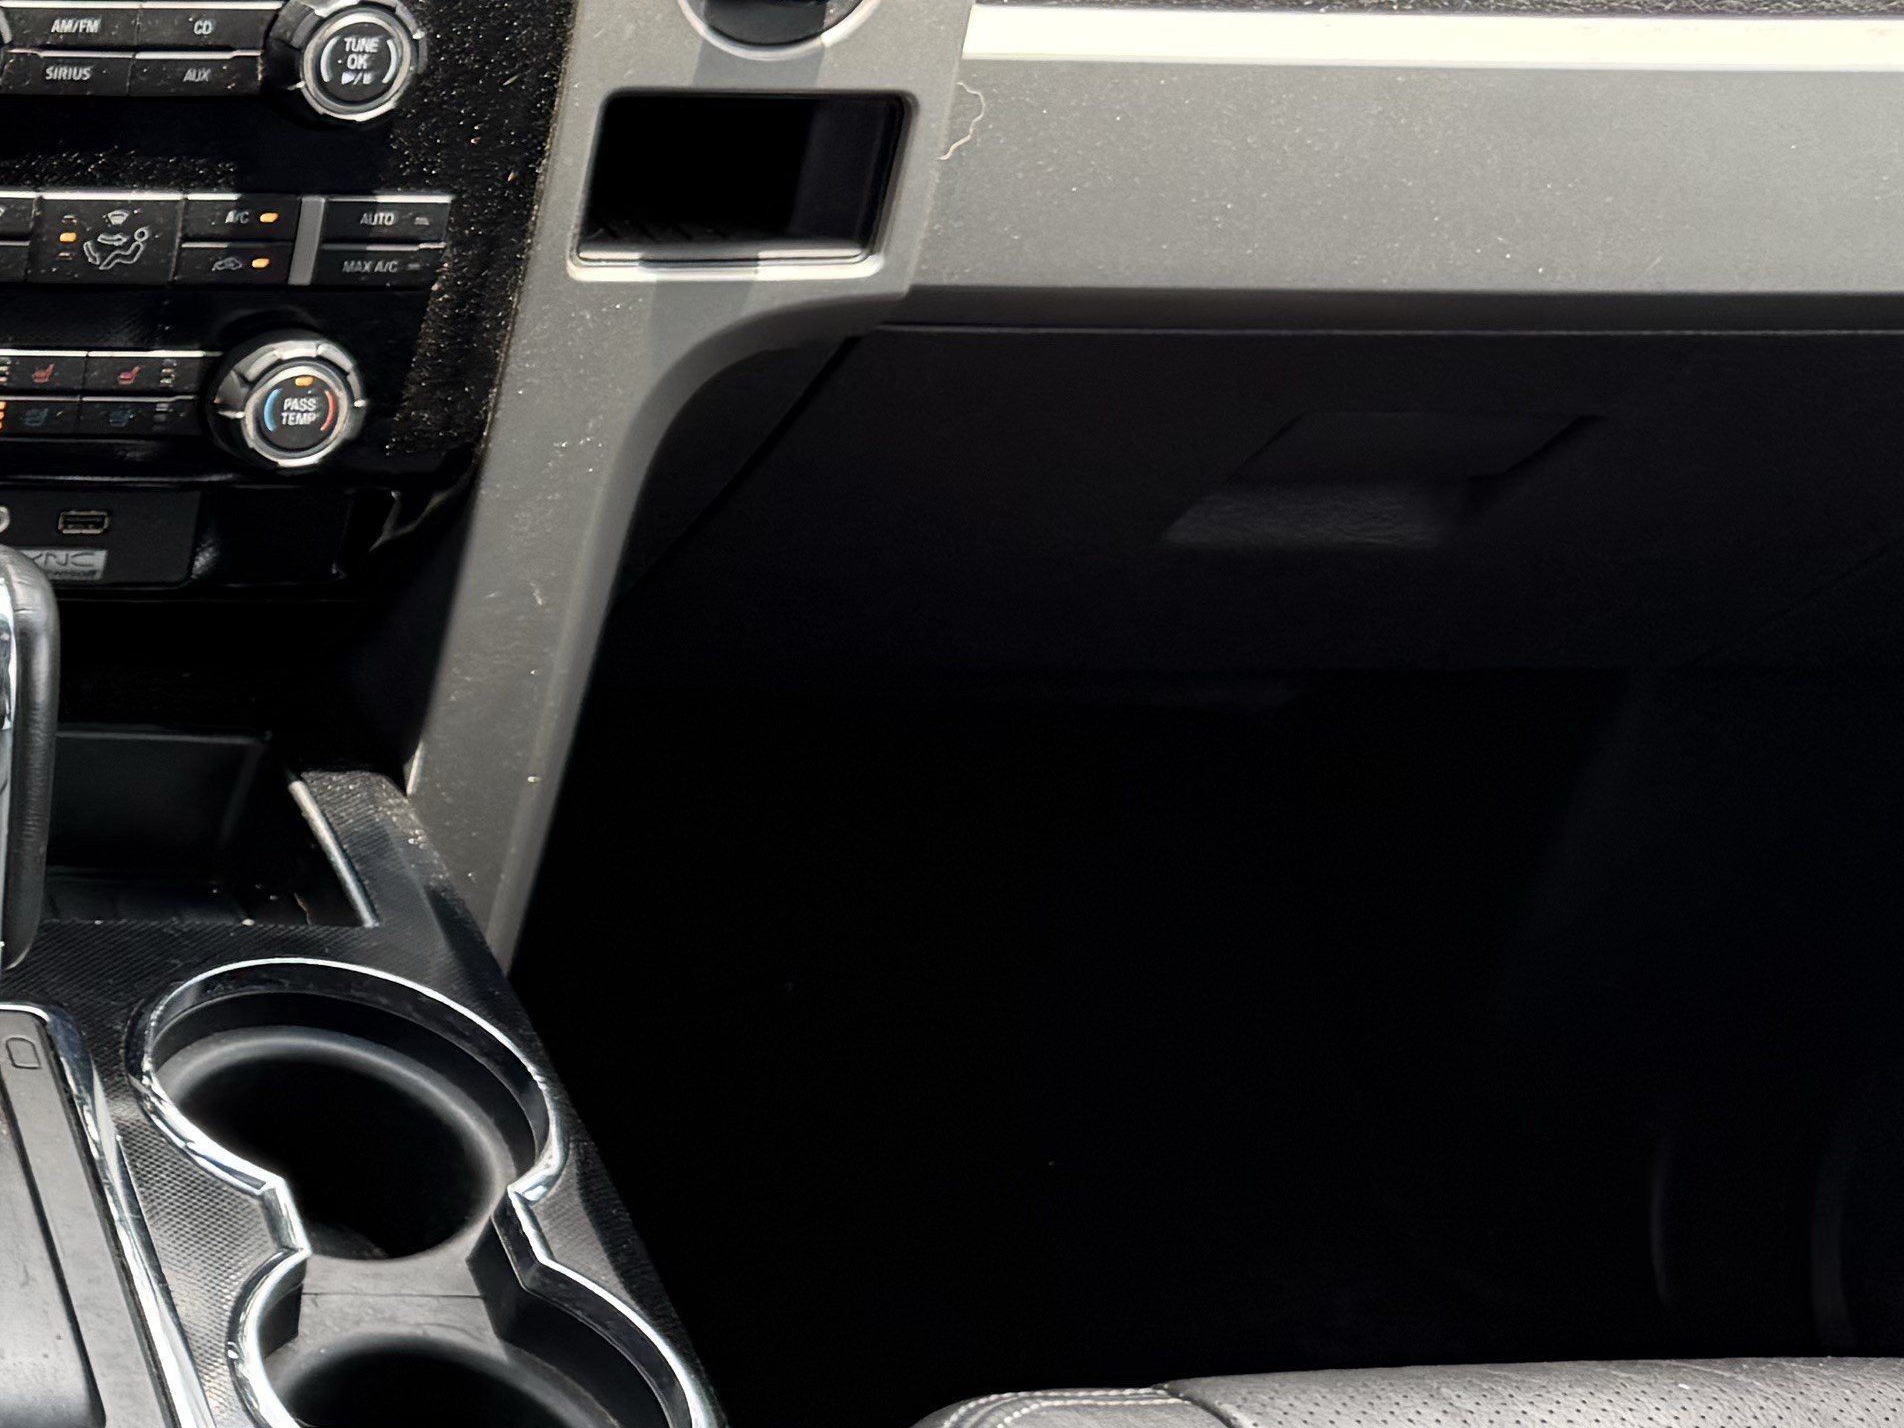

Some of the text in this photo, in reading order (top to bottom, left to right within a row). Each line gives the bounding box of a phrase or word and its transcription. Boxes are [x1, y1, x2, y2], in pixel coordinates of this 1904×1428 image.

[51, 17, 100, 35] AM/FM
[194, 19, 213, 35] CD
[344, 36, 379, 53] TUNE
[347, 53, 369, 71] OK
[46, 64, 92, 82] SIRIUS
[183, 67, 210, 83] AUX
[225, 210, 250, 224] A/C
[360, 212, 395, 227] AUTO
[342, 260, 398, 273] MAX A/C
[283, 397, 317, 411] PASS
[281, 412, 317, 426] TEMP
